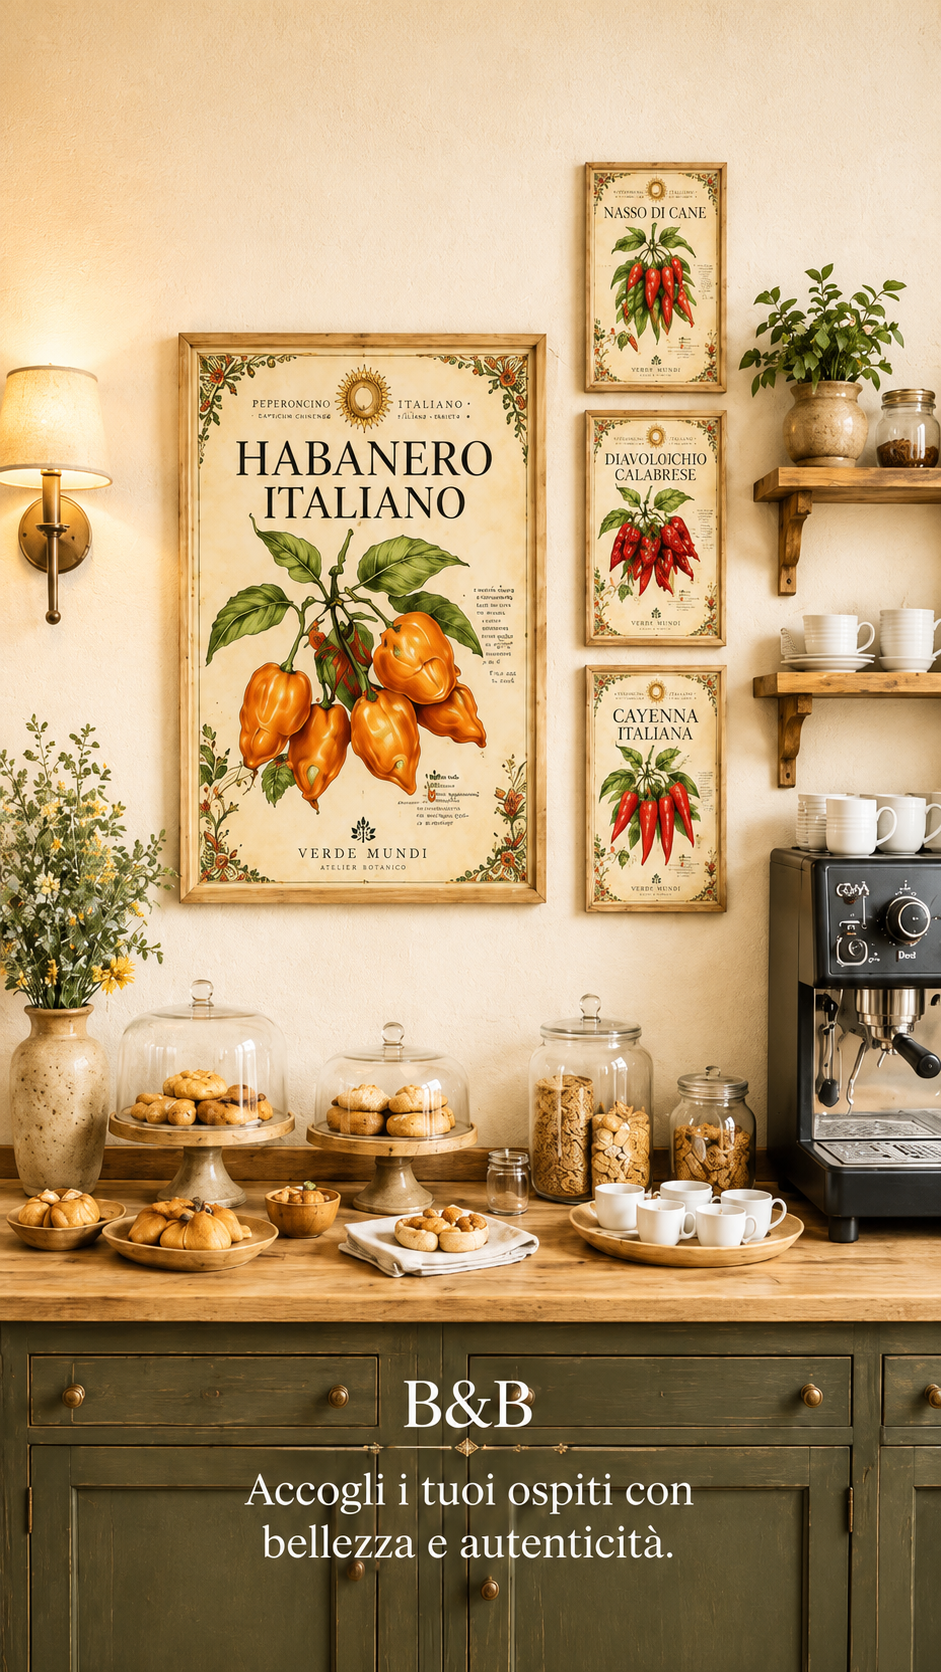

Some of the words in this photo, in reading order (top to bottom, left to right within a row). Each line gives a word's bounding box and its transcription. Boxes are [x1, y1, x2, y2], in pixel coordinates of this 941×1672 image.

[603, 206, 648, 219] NASSO
[651, 206, 666, 219] DI
[669, 206, 707, 219] CANE
[252, 399, 331, 409] PEPERONCINO
[398, 399, 463, 409] ITALIANO
[236, 440, 492, 476] HABANERO
[614, 468, 697, 481] CALABRESE
[264, 486, 465, 519] ITALIANO
[613, 708, 699, 723] CAYENNA
[618, 727, 693, 740] ITALIANA
[298, 848, 357, 859] VERDE
[367, 848, 427, 859] MUNDI
